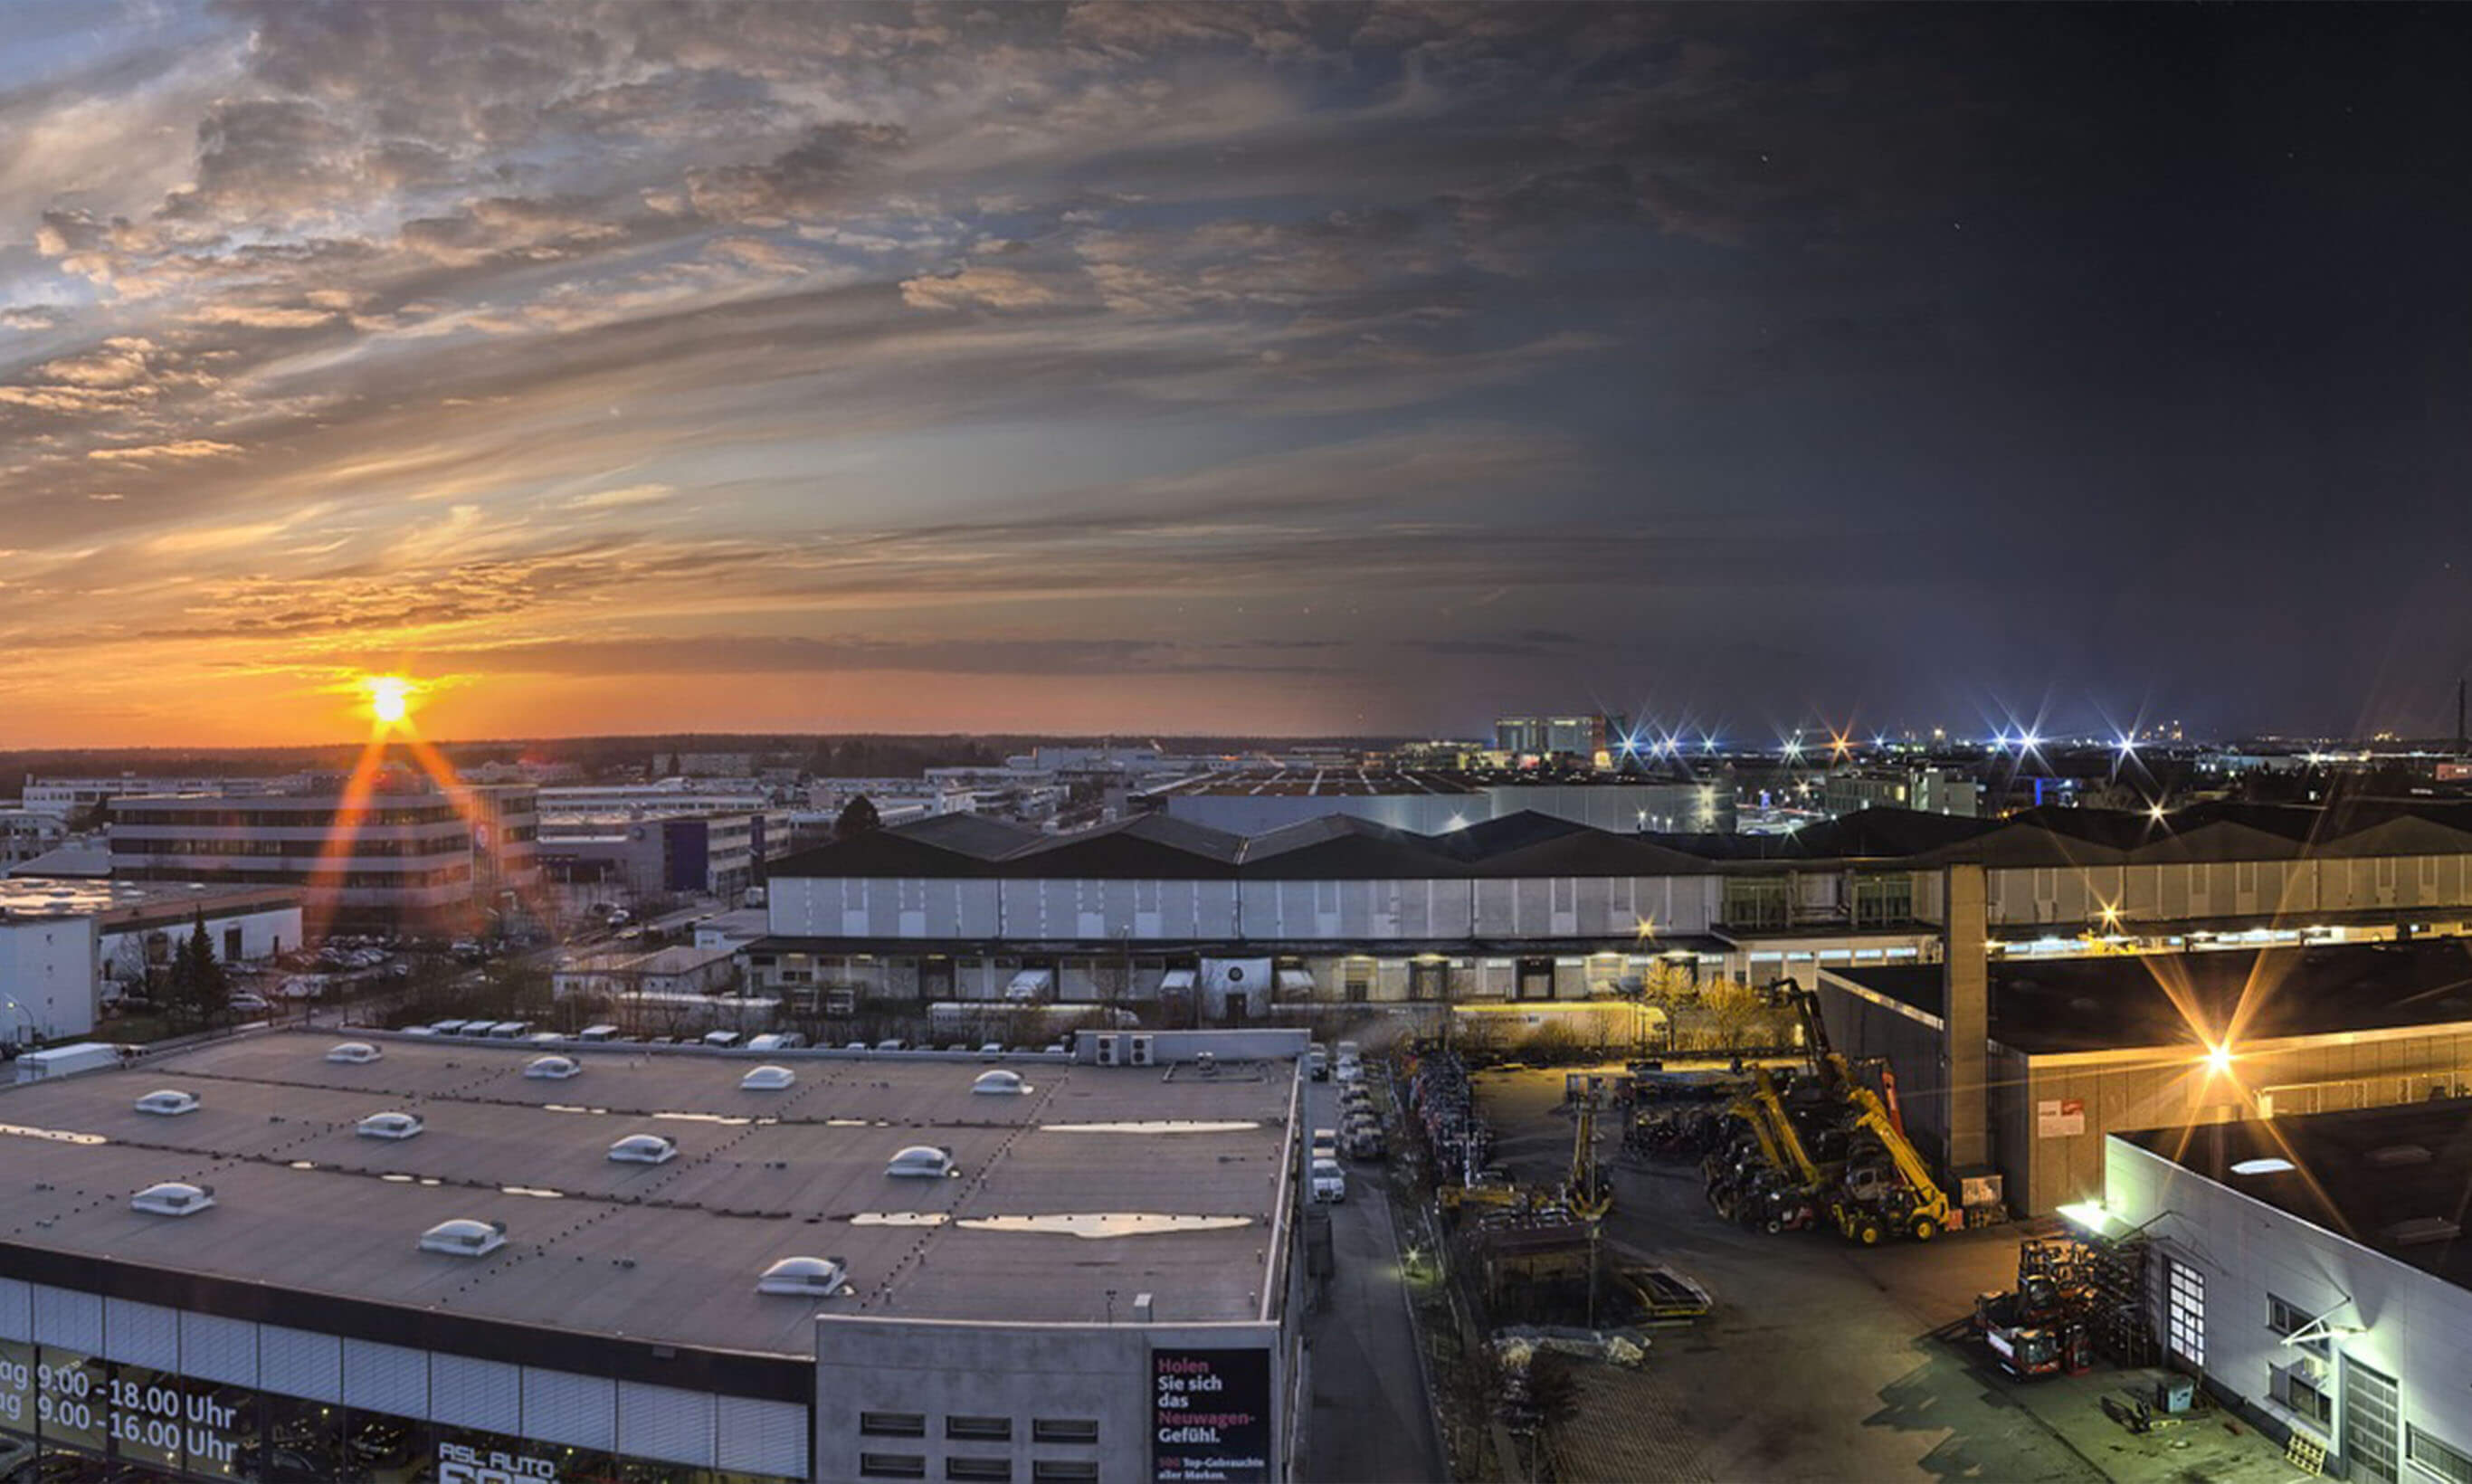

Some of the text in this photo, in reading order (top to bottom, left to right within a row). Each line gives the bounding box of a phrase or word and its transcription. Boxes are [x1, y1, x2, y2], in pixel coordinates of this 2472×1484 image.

[1158, 1358, 1209, 1373] Holen
[1158, 1375, 1222, 1391] Sie sich
[37, 1363, 90, 1398] 9.00
[186, 1394, 236, 1429] Uhr
[1158, 1393, 1189, 1408] das
[37, 1394, 90, 1430] 9.00
[186, 1427, 239, 1463] Uhr
[1158, 1412, 1256, 1429] Neuwagen-
[1158, 1427, 1221, 1443] Gefühl.
[490, 1451, 556, 1479] AUTO
[1158, 1470, 1182, 1480] aller
